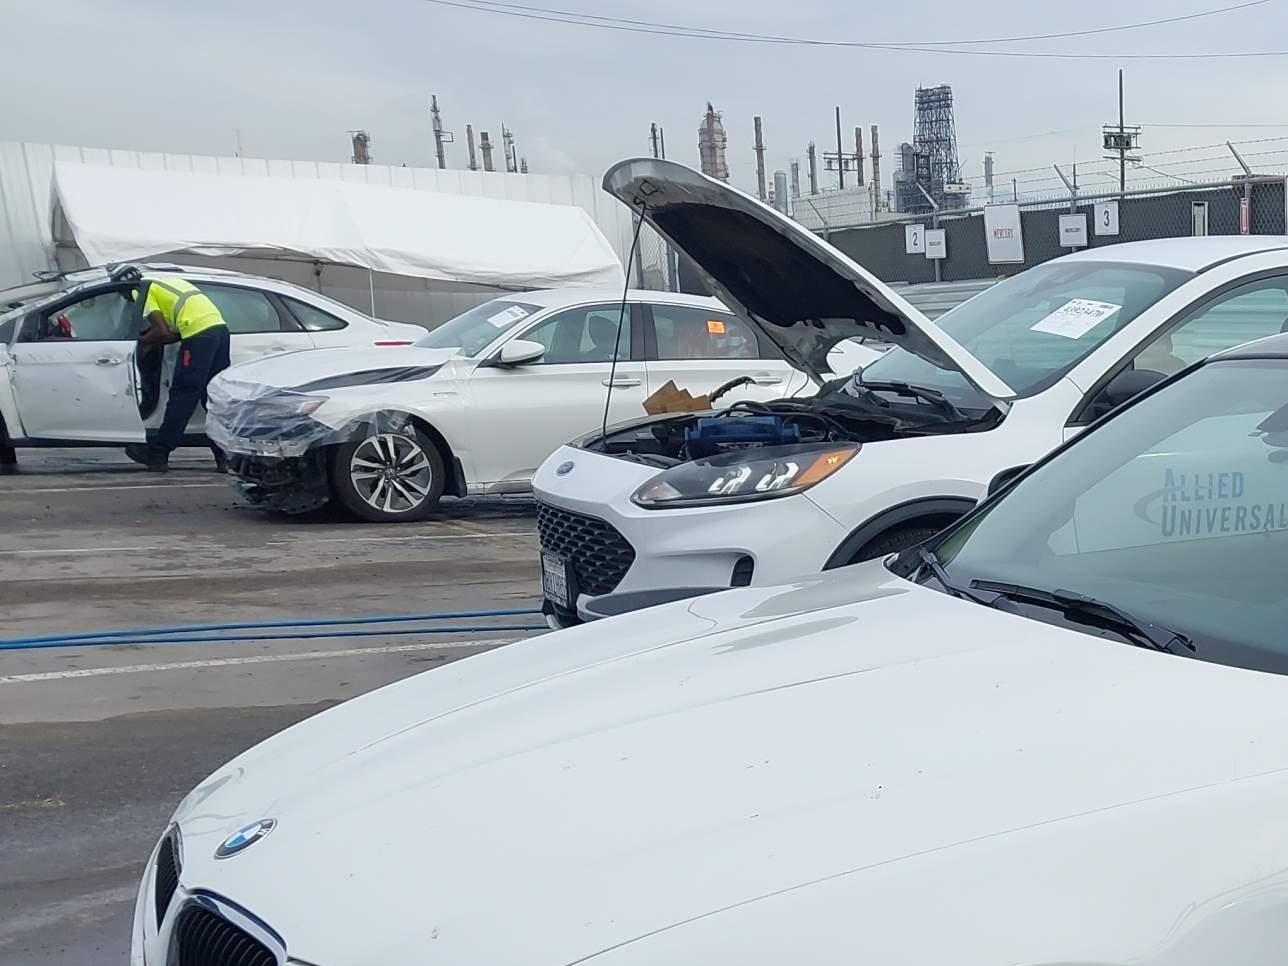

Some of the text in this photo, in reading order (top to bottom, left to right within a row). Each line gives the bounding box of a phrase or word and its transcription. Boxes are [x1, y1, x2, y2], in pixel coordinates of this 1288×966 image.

[1104, 210, 1110, 226] 3
[913, 232, 918, 246] 2
[1163, 468, 1244, 502] ALLIED
[1162, 503, 1288, 536] UNIVERSAL
